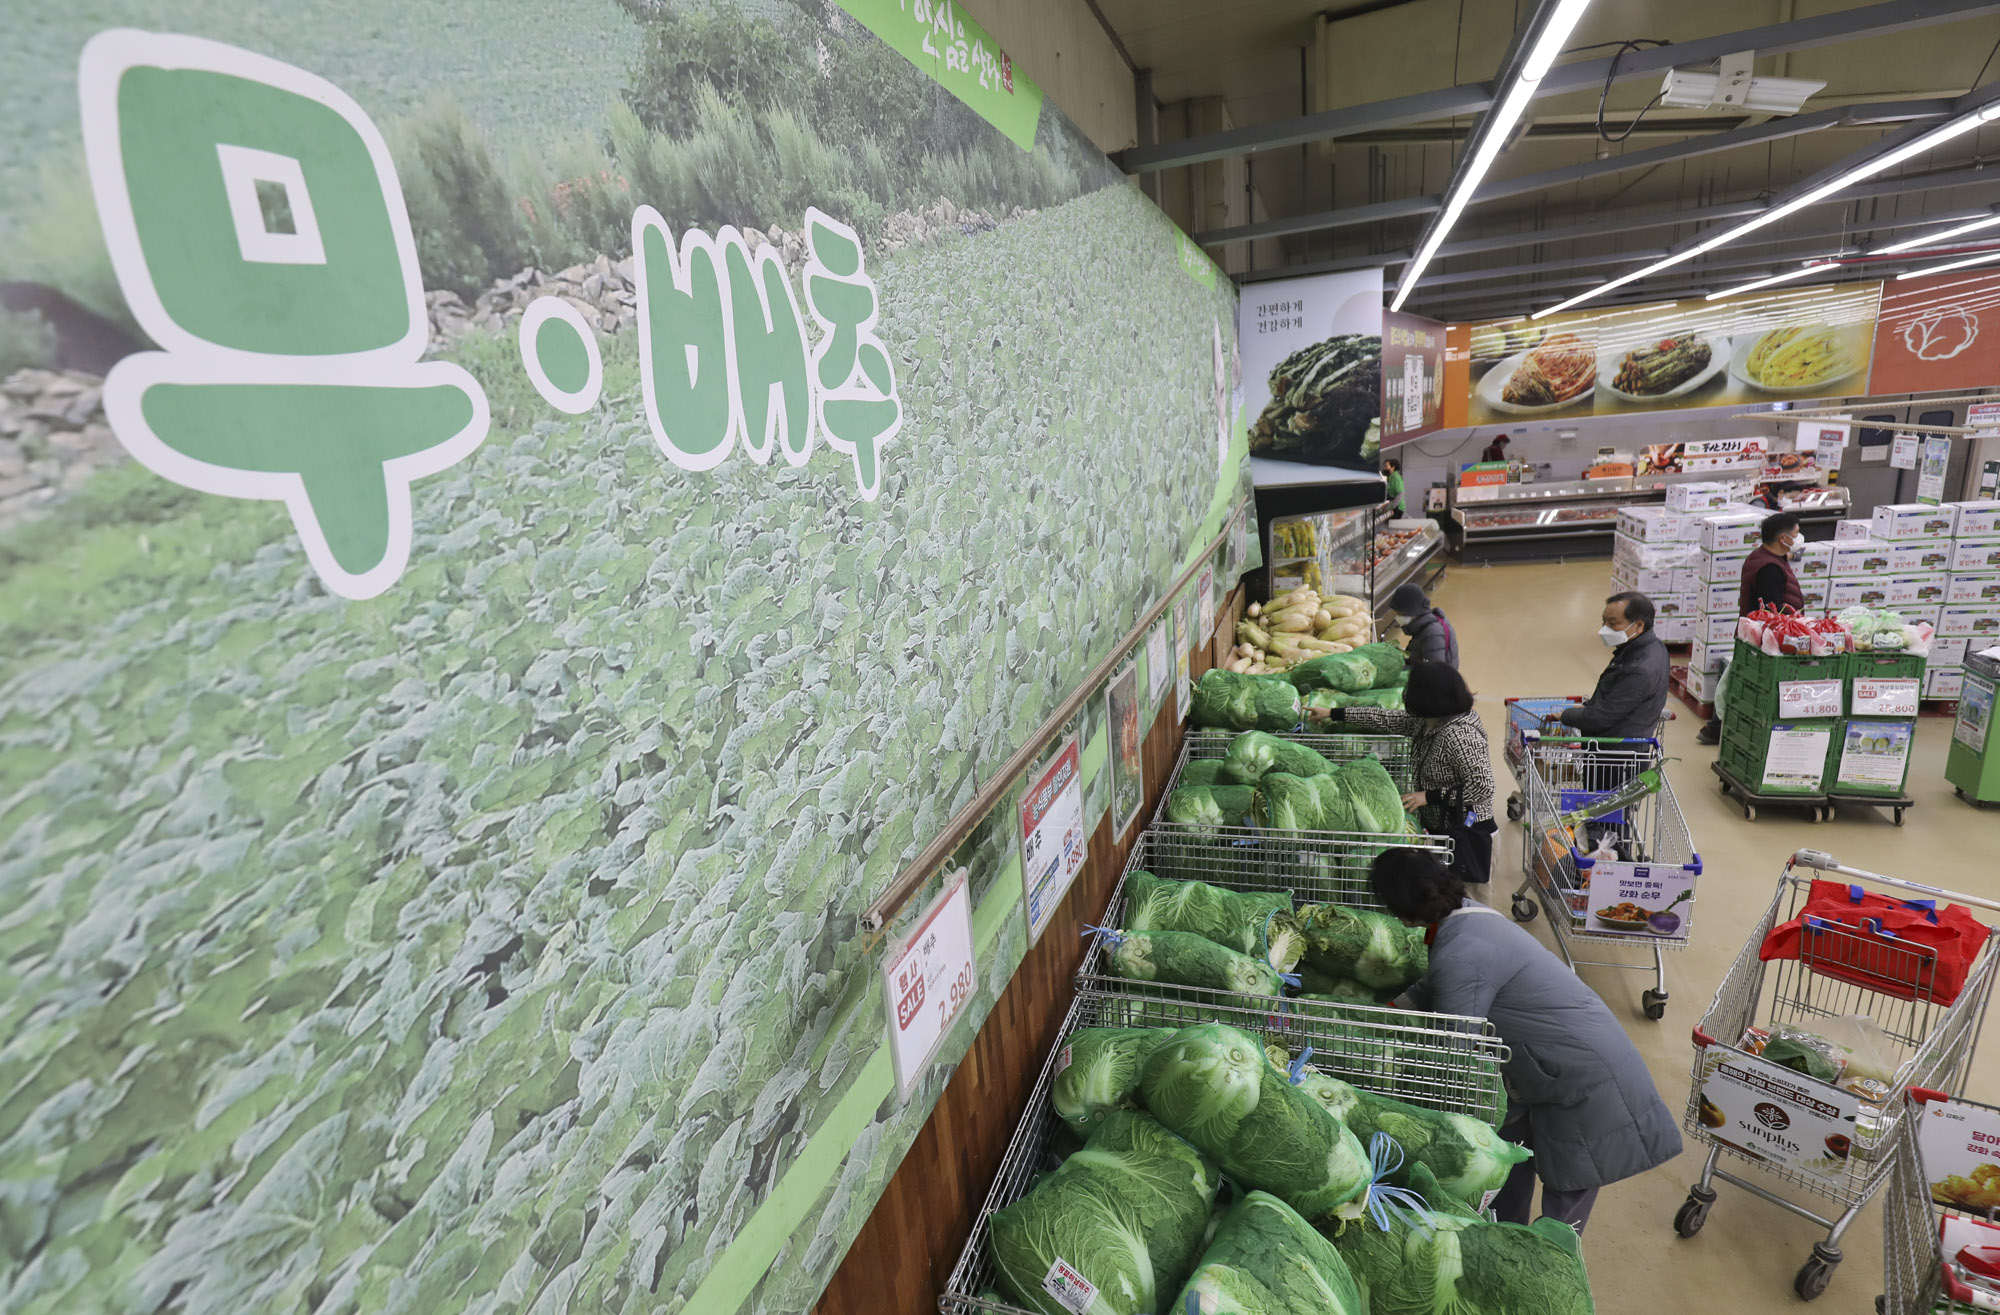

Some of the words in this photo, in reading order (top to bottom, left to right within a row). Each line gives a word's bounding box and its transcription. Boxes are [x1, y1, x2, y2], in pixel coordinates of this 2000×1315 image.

[1256, 300, 1303, 317] 간편하게
[1256, 316, 1303, 333] 건강하게
[1803, 705, 1838, 715] 41,800
[1619, 880, 1643, 888] 맛보면
[1644, 881, 1663, 889] 중독!
[1619, 889, 1638, 898] 강화
[1641, 891, 1661, 900] 순무
[923, 932, 937, 956] 배추
[900, 983, 925, 1024] SALE
[938, 961, 972, 1031] 2,980
[1719, 1074, 1742, 1087] 대한민국
[1742, 1083, 1753, 1091] 대표
[1747, 1066, 1757, 1074] 7년
[1757, 1070, 1771, 1080] 연속
[1771, 1075, 1796, 1090] 소비자가
[1719, 1064, 1747, 1081] 올해의
[1747, 1076, 1766, 1088] 과일
[1766, 1083, 1795, 1099] 브랜드
[1795, 1094, 1815, 1108] 대상
[1817, 1103, 1838, 1117] 수상
[1945, 1112, 1966, 1122] 강화군
[1738, 1120, 1800, 1152] sunplus
[1967, 1143, 1989, 1156] 강화
